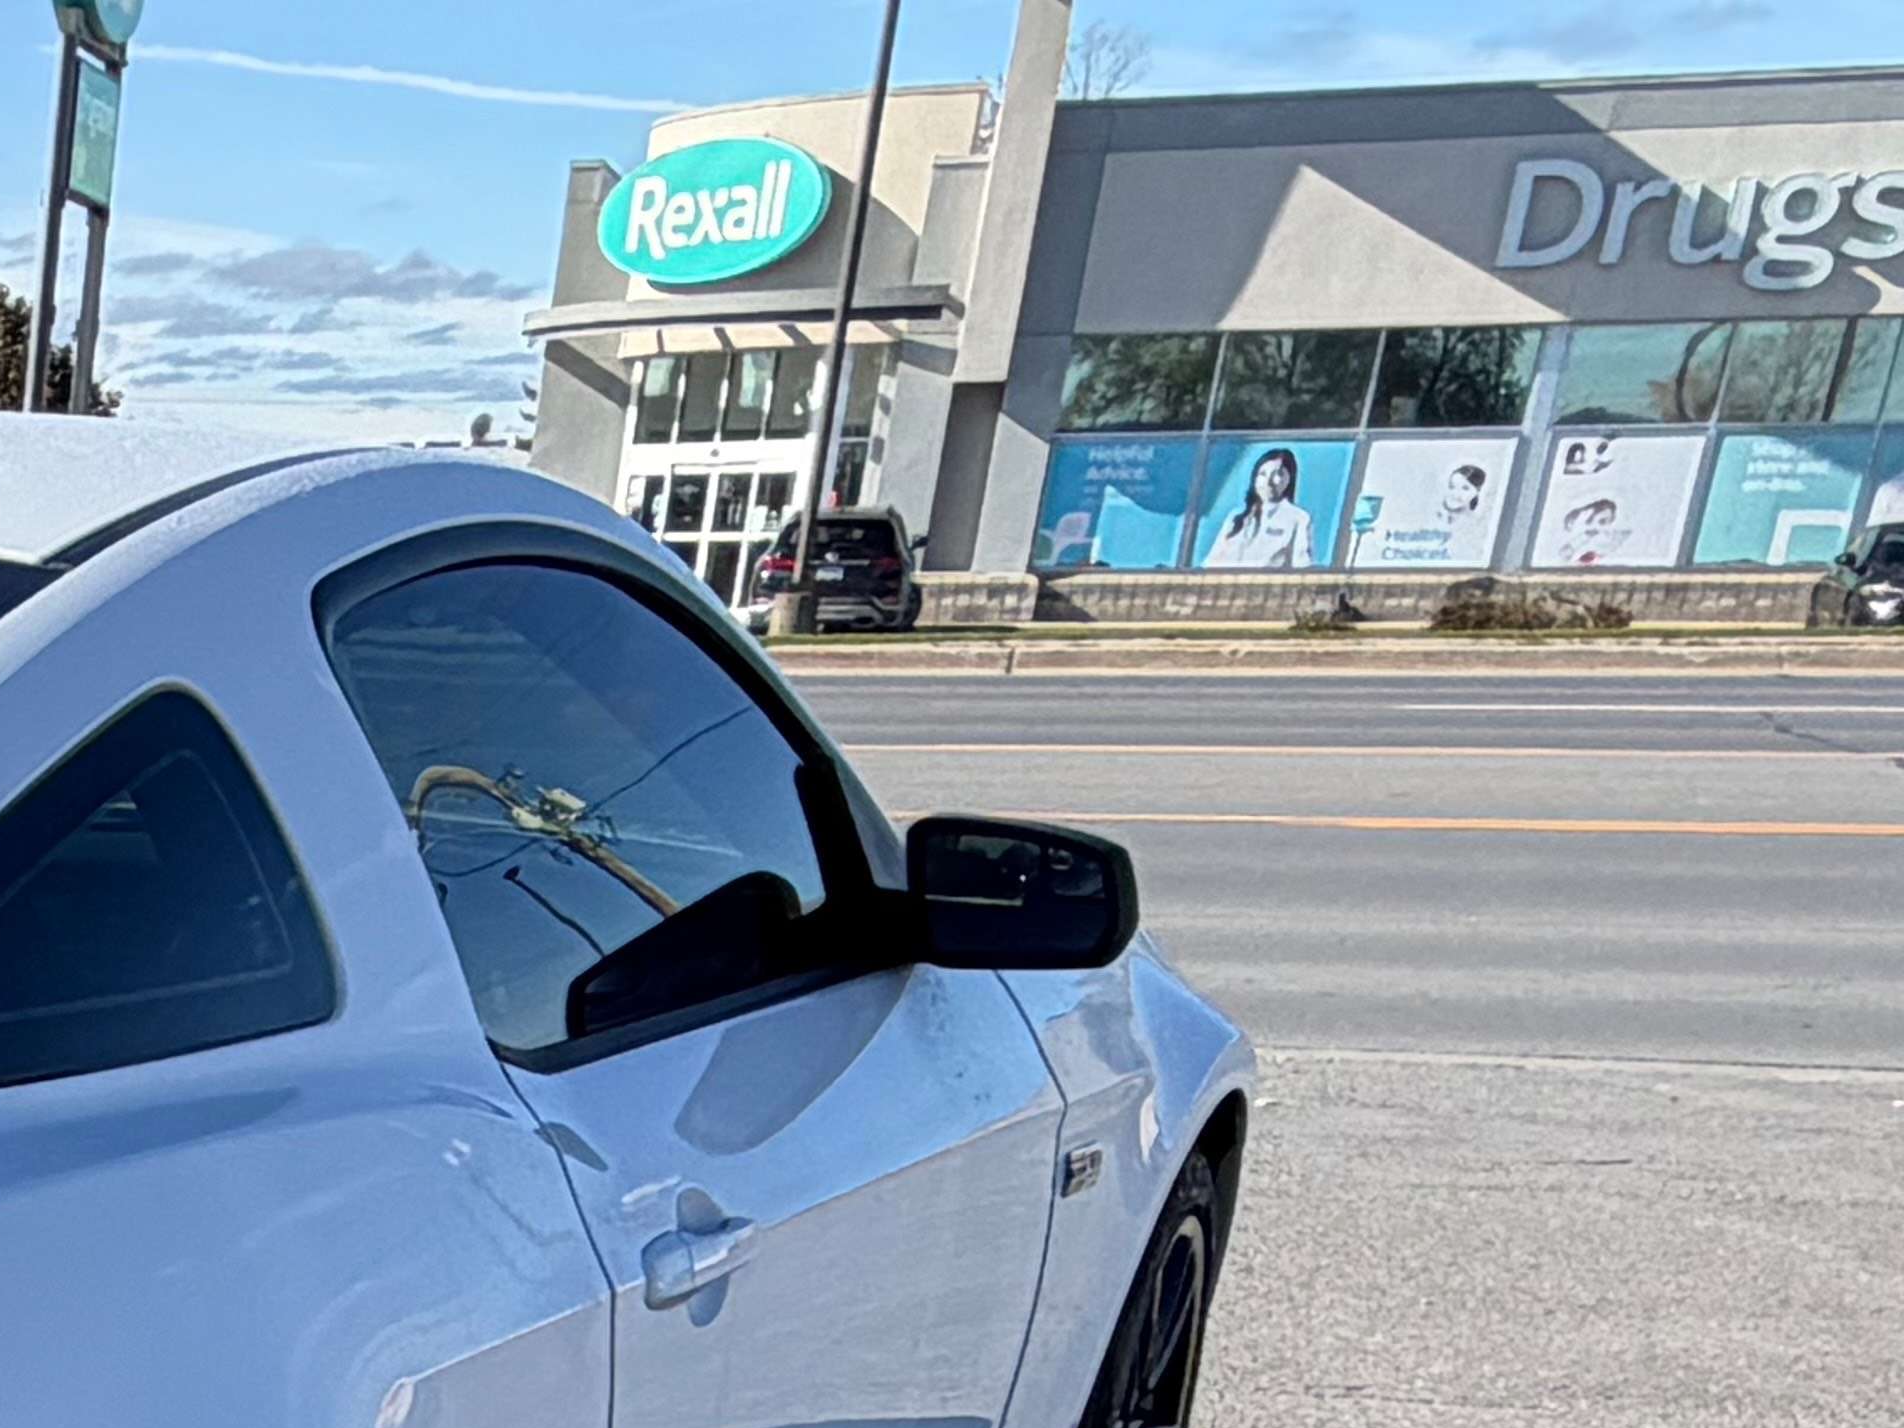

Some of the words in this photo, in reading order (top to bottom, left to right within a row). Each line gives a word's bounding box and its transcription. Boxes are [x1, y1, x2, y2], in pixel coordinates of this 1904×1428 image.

[624, 158, 793, 261] Rexall
[1494, 157, 1904, 291] Drugs
[1385, 527, 1452, 547] Healthy
